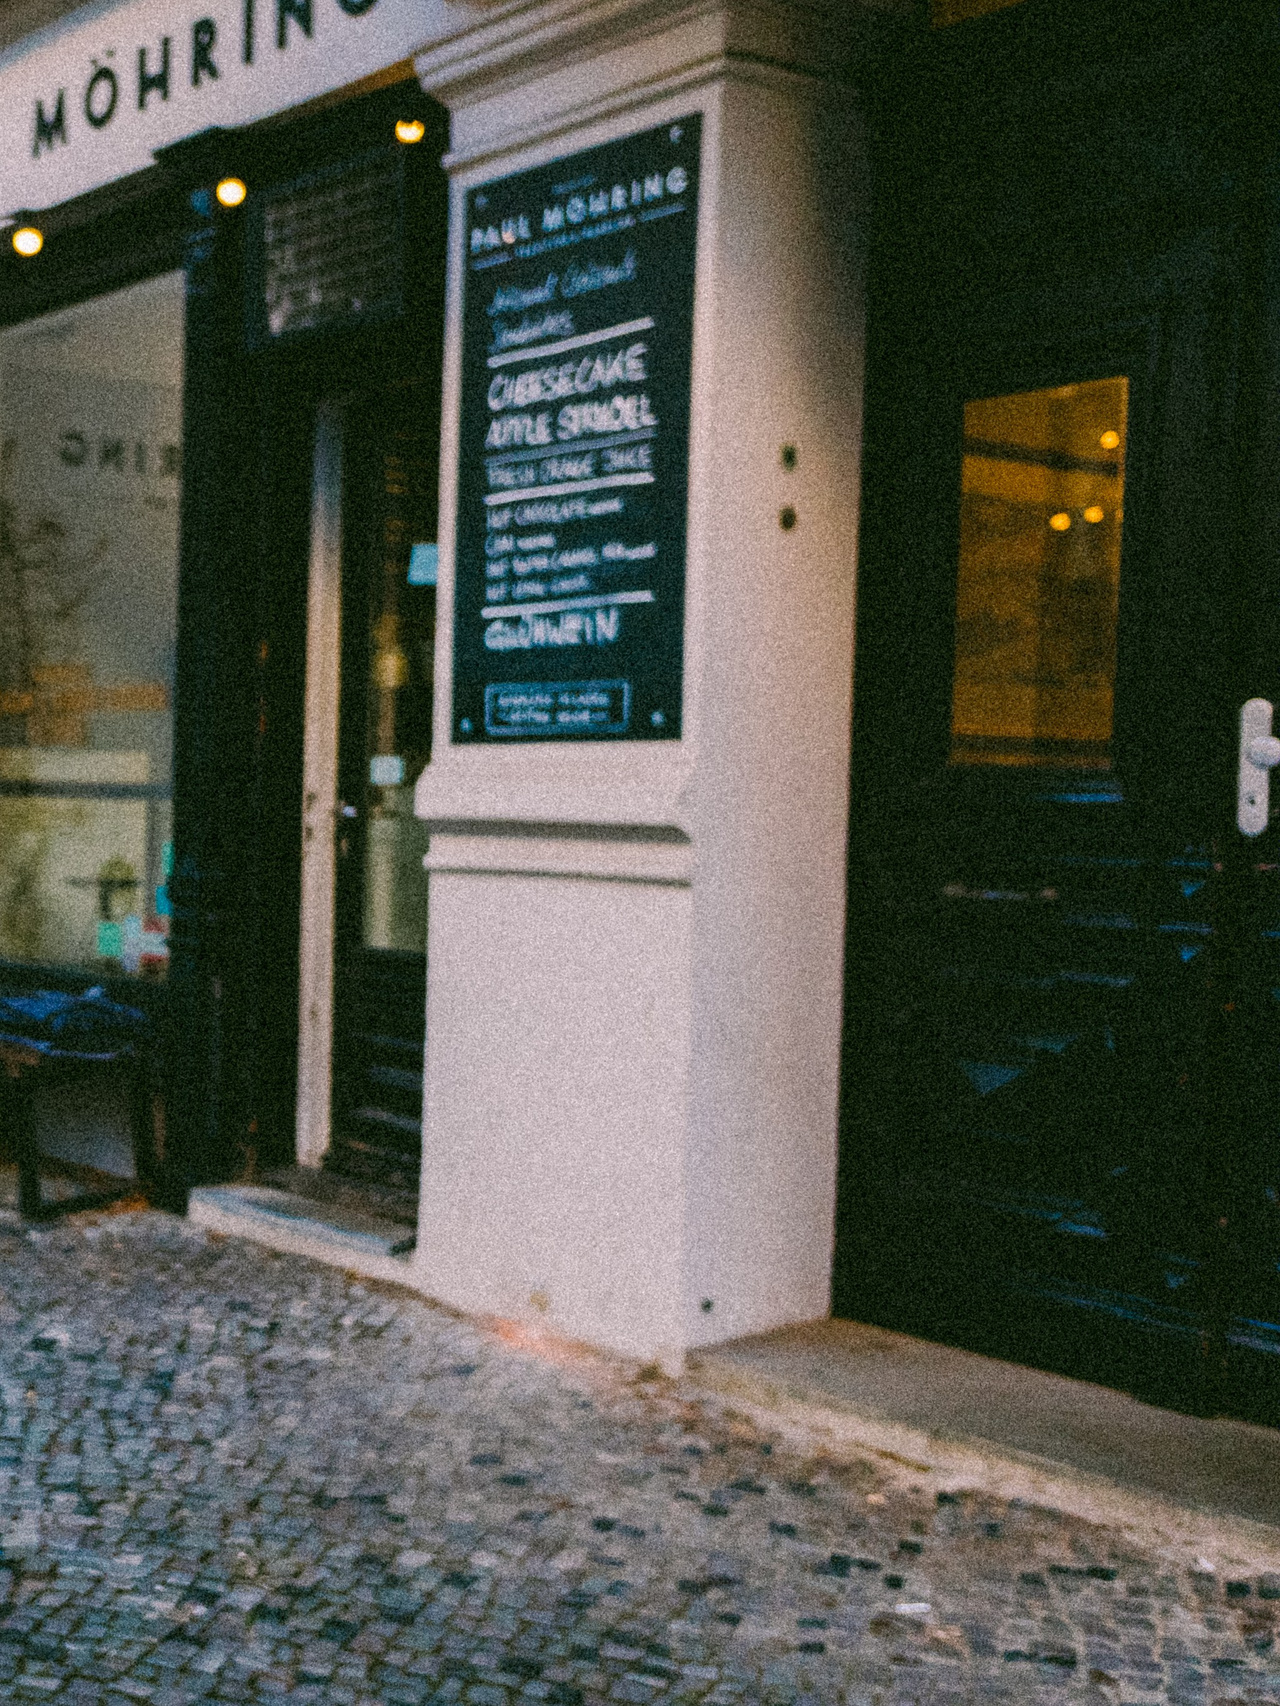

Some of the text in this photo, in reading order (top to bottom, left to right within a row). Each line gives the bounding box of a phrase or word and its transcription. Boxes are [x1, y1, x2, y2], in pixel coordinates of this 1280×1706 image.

[32, 0, 378, 159] MÖHRIN
[469, 214, 533, 253] PAUL
[487, 341, 648, 411] CHEESECAKE
[484, 394, 660, 449] APPLE STRUDEL
